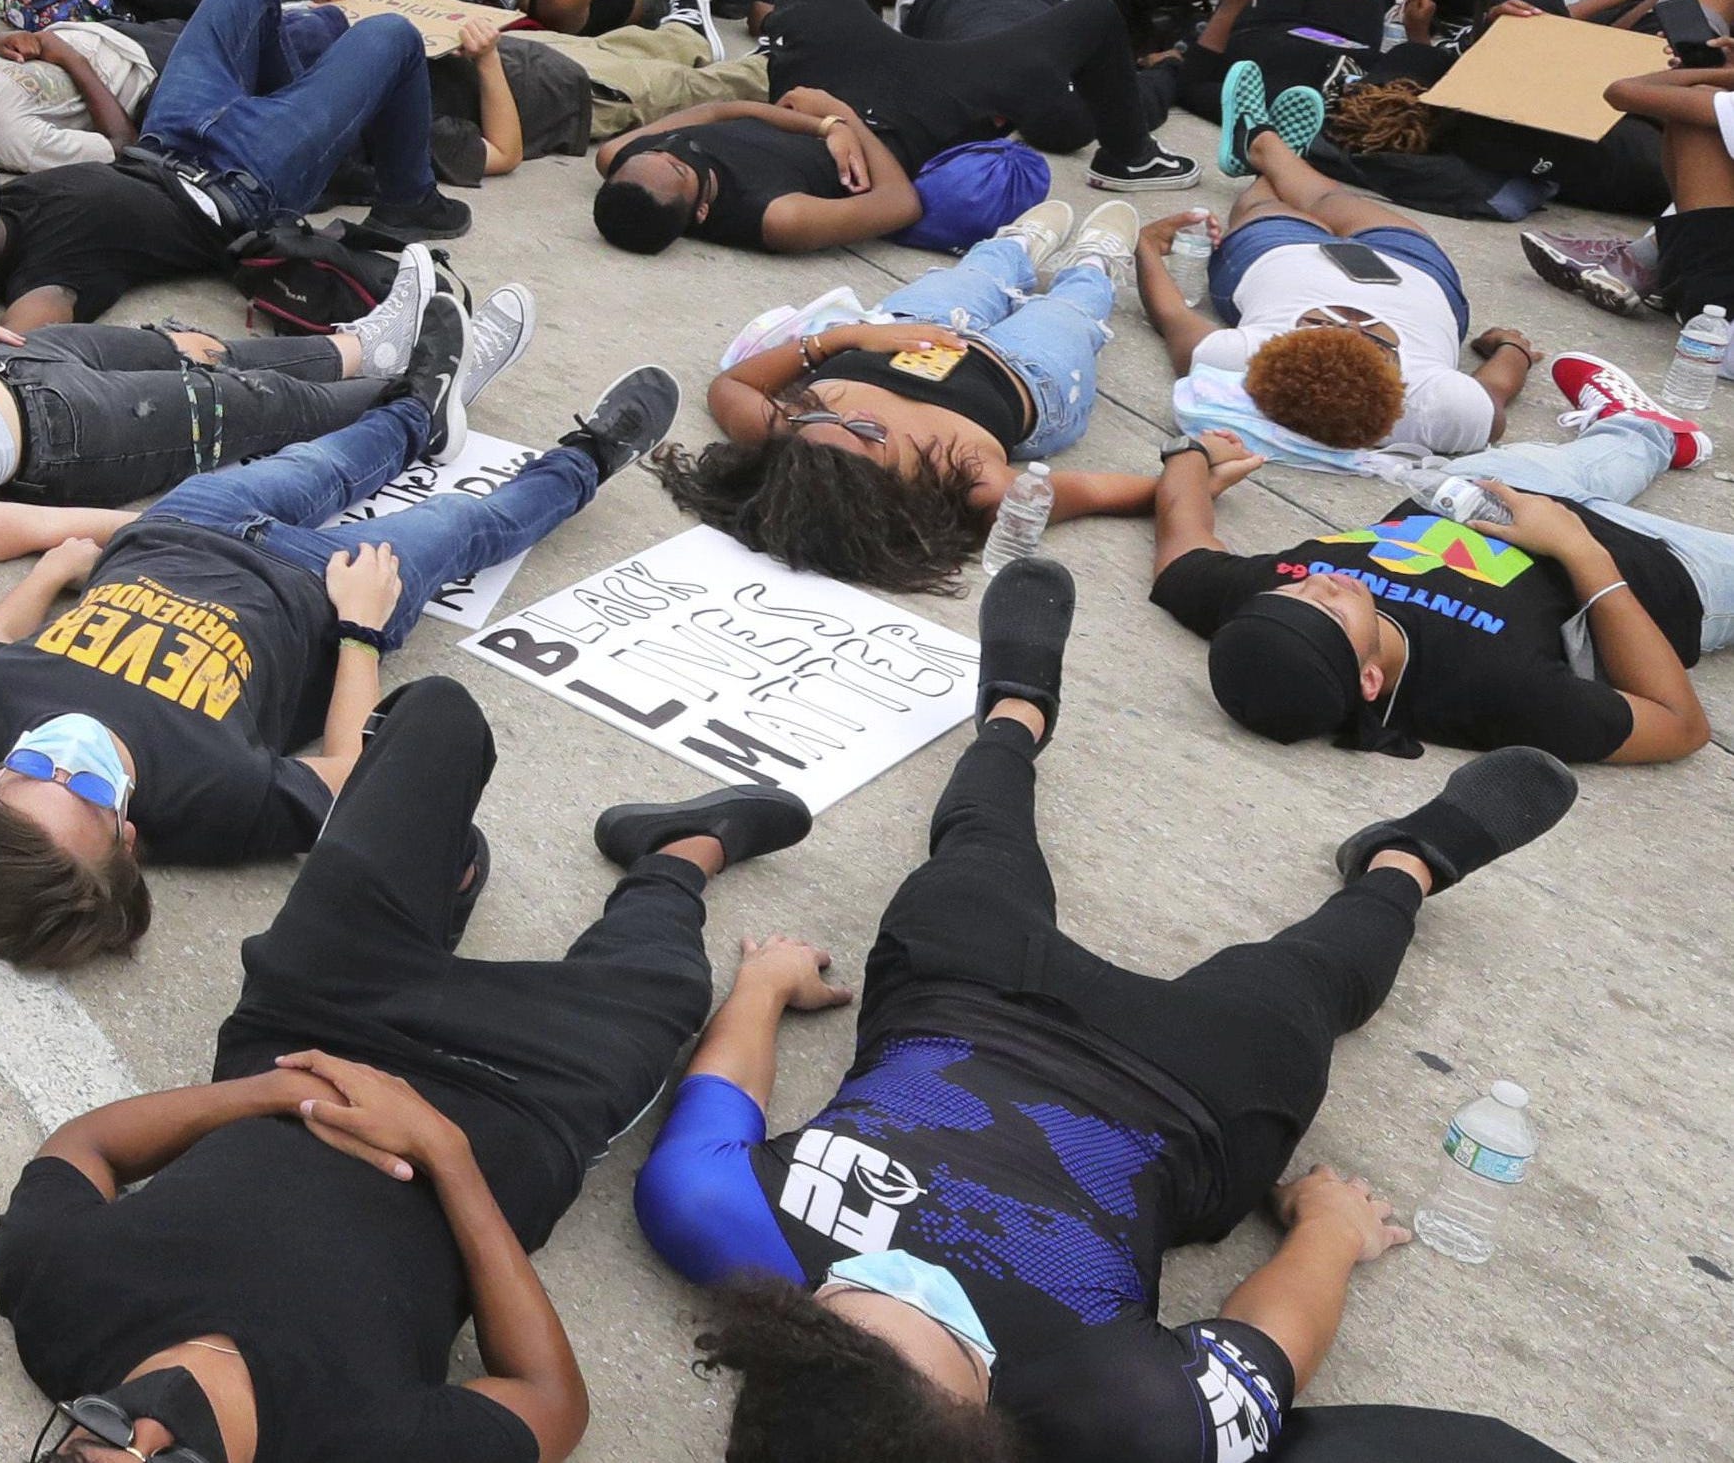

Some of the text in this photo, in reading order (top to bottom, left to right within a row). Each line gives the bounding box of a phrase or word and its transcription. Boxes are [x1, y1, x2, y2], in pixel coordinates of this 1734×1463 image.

[479, 561, 709, 678] BLACK
[565, 583, 854, 731] LIVES
[1308, 561, 1507, 636] NINTENDO
[34, 603, 242, 722] NEVER
[681, 623, 981, 790] MATTER
